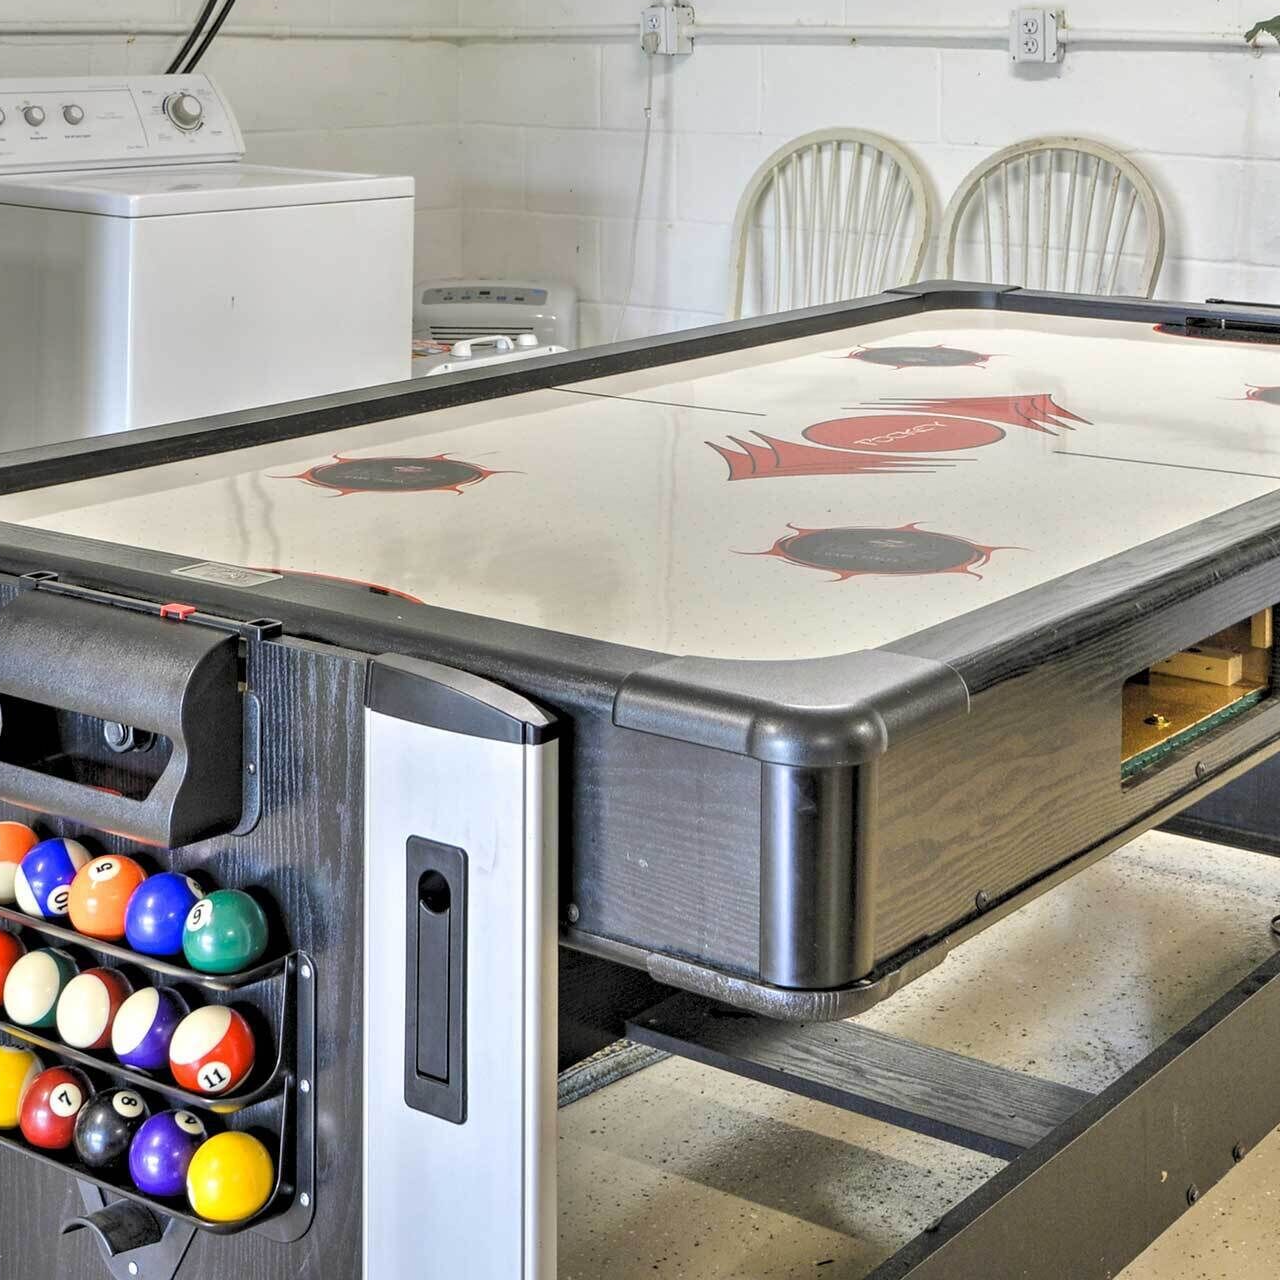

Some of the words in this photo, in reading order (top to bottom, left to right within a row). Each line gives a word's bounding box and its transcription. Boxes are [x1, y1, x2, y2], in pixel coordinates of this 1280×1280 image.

[96, 862, 113, 874] 5
[54, 891, 69, 912] 10
[203, 1067, 227, 1089] 11
[57, 1090, 72, 1107] 7
[121, 1096, 138, 1107] 8
